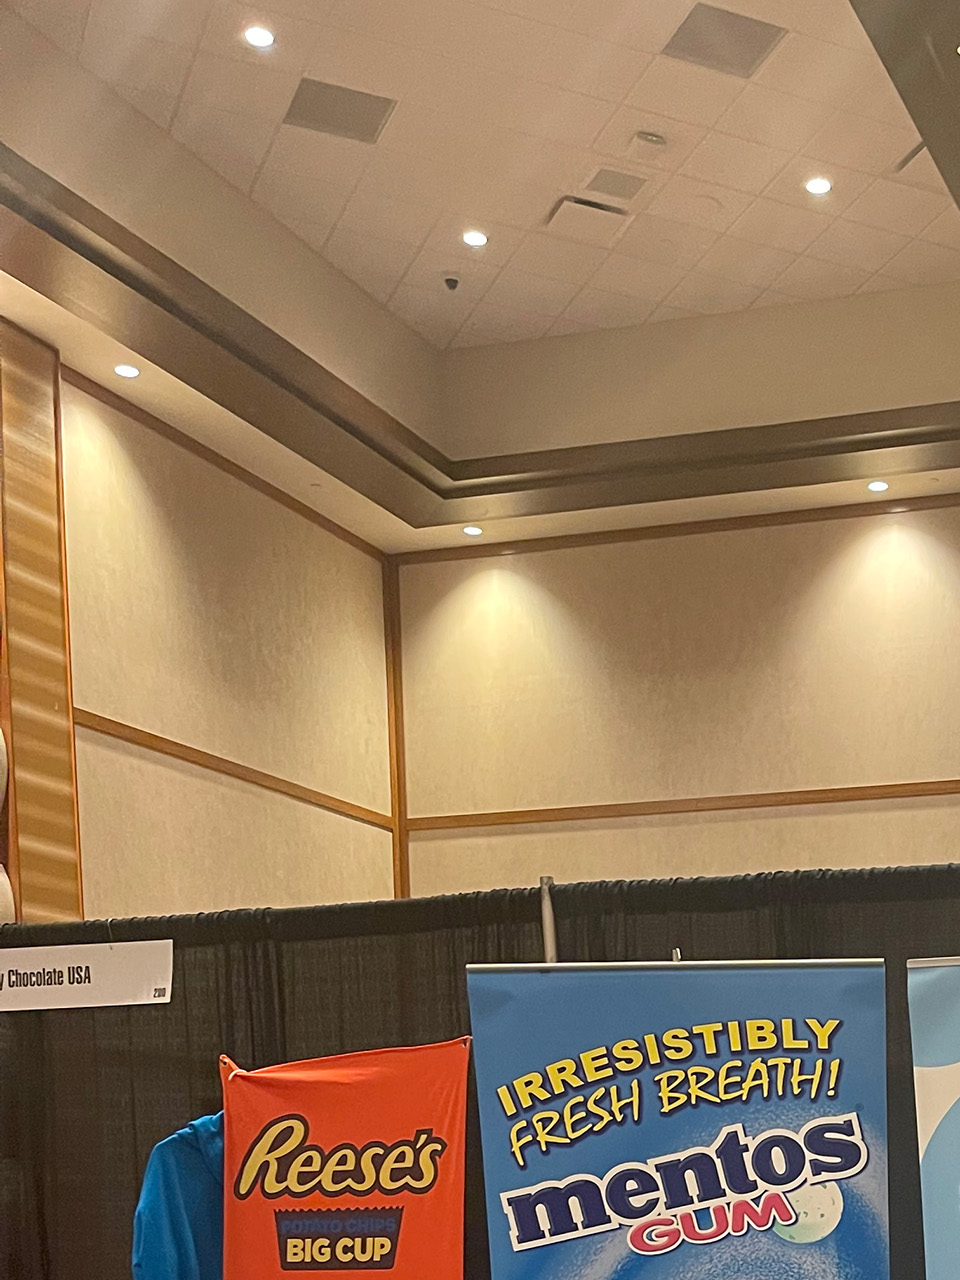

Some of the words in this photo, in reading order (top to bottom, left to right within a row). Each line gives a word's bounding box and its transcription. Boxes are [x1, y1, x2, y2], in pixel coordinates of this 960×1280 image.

[8, 967, 64, 988] Chocolate
[67, 965, 91, 985] USA
[496, 1017, 843, 1117] IRRESISTIBLY
[508, 1077, 641, 1168] FRESH
[653, 1056, 842, 1114] BREATH!
[237, 1117, 443, 1197] Reese's
[503, 1116, 865, 1247] mentos
[286, 1238, 331, 1263] BIG
[335, 1237, 391, 1262] CUP
[628, 1191, 797, 1255] GUM
